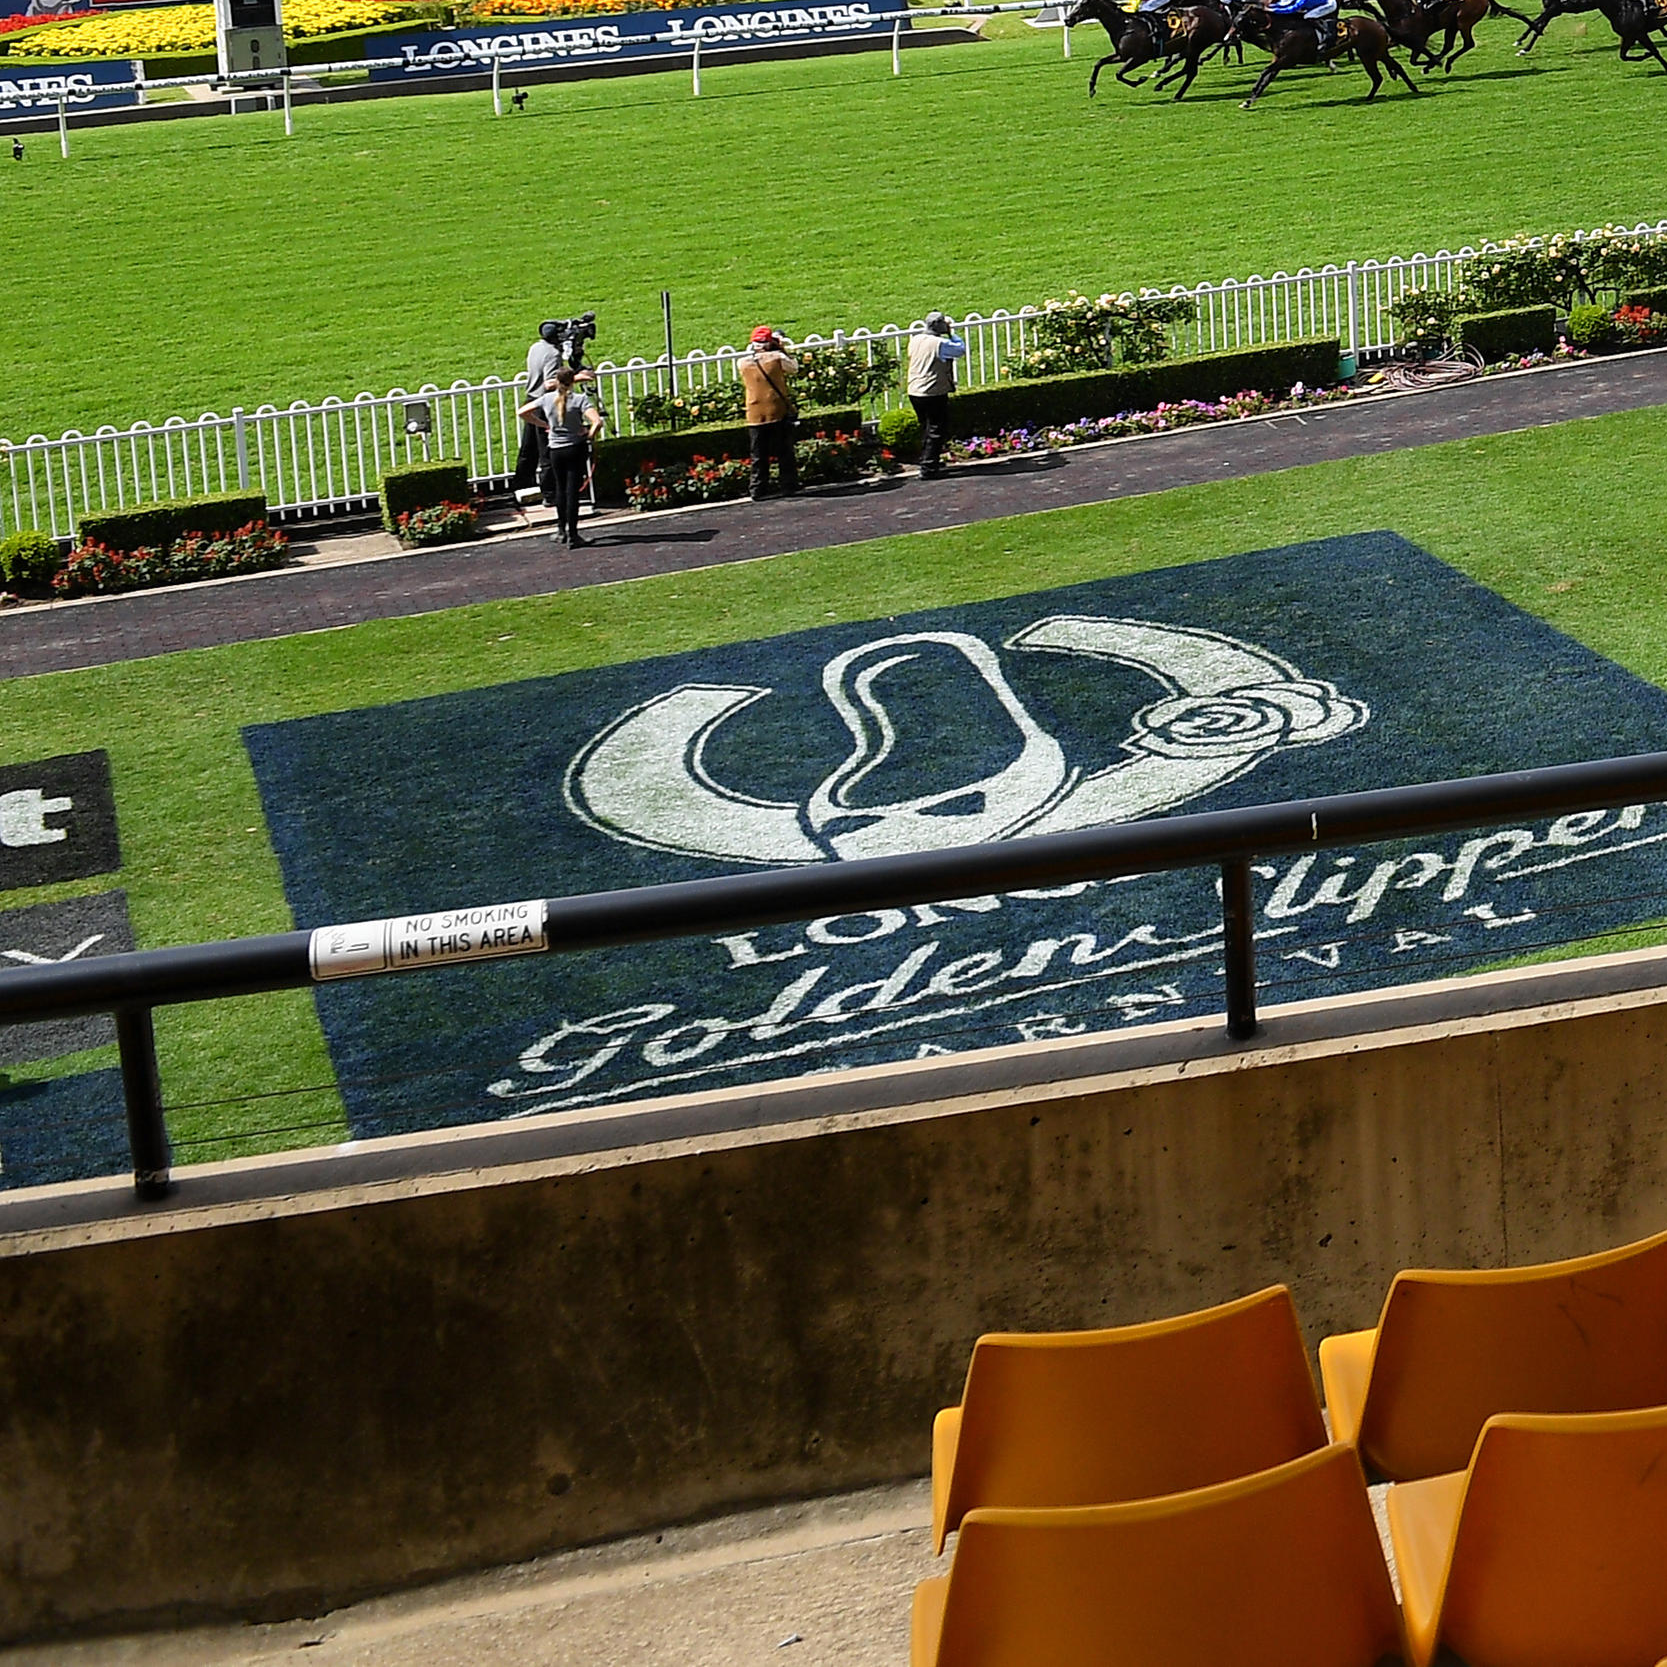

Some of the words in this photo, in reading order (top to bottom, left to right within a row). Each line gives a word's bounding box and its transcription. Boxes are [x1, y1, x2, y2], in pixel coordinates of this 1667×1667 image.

[401, 24, 622, 73] LONGINES
[666, 1, 872, 47] LONGINES
[406, 917, 433, 934] NO
[441, 904, 529, 929] SMOKING
[400, 939, 419, 960] IN
[428, 933, 471, 956] THIS
[480, 925, 534, 949] AREA
